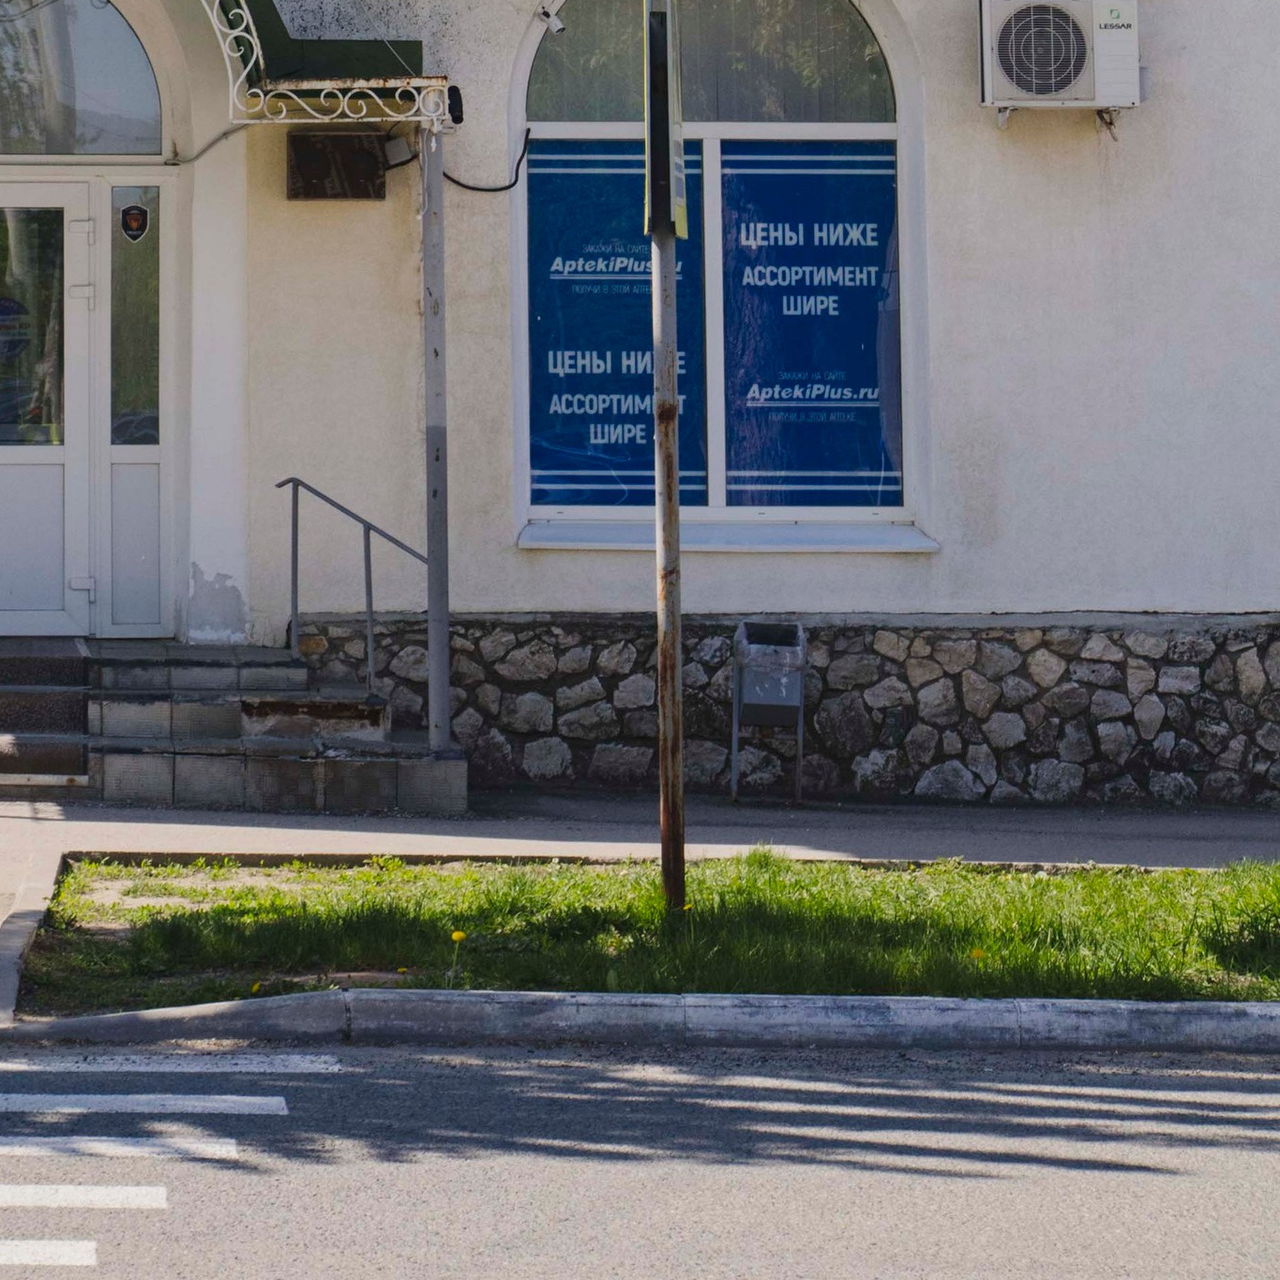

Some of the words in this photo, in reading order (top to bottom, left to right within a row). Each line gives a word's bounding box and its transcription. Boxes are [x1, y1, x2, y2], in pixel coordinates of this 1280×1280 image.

[1099, 22, 1132, 30] LESSAR
[740, 222, 804, 249] ЦЕНЫ
[813, 222, 879, 247] НИЖЕ
[742, 266, 879, 287] АССОРТИМЕНТ
[782, 295, 840, 316] ШИРЕ
[547, 350, 612, 377] ЦЕНЫ
[621, 350, 687, 375] НИЕ
[746, 383, 879, 403] AptekiPlus.ru
[548, 393, 687, 415] АССОРТИМТ
[589, 423, 647, 445] ШИРЕ
